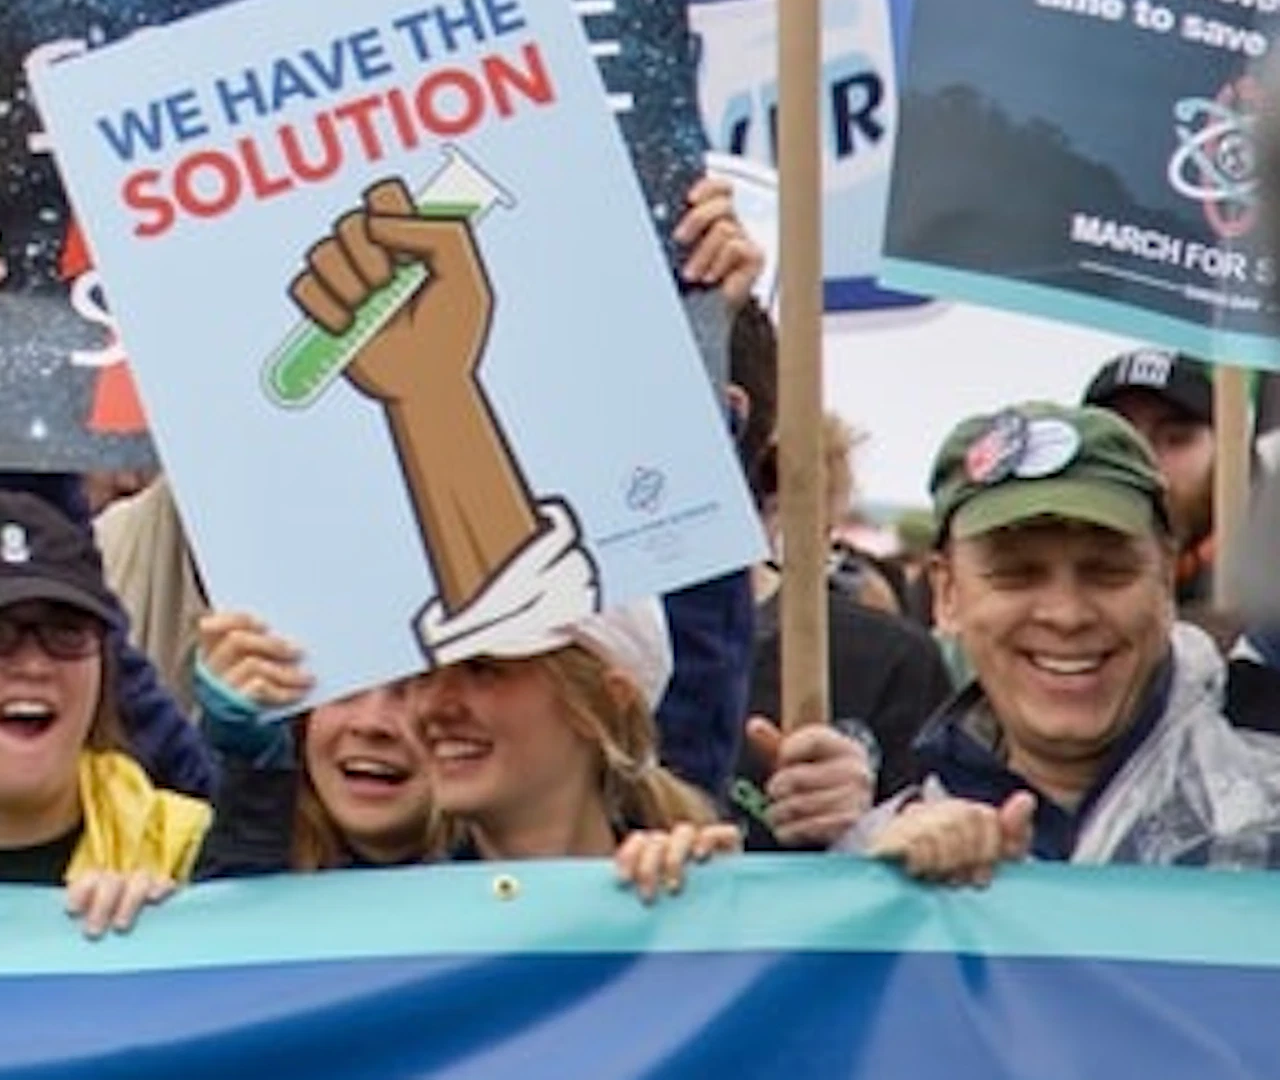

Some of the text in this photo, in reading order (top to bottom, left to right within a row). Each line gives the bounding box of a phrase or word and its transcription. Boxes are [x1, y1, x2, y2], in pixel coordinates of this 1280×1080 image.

[1180, 14, 1269, 57] save
[100, 88, 205, 163] WE
[216, 25, 395, 126] HAVE
[122, 41, 556, 239] SOLUTION
[1070, 212, 1183, 266] MARCH
[1184, 241, 1247, 282] FOR
